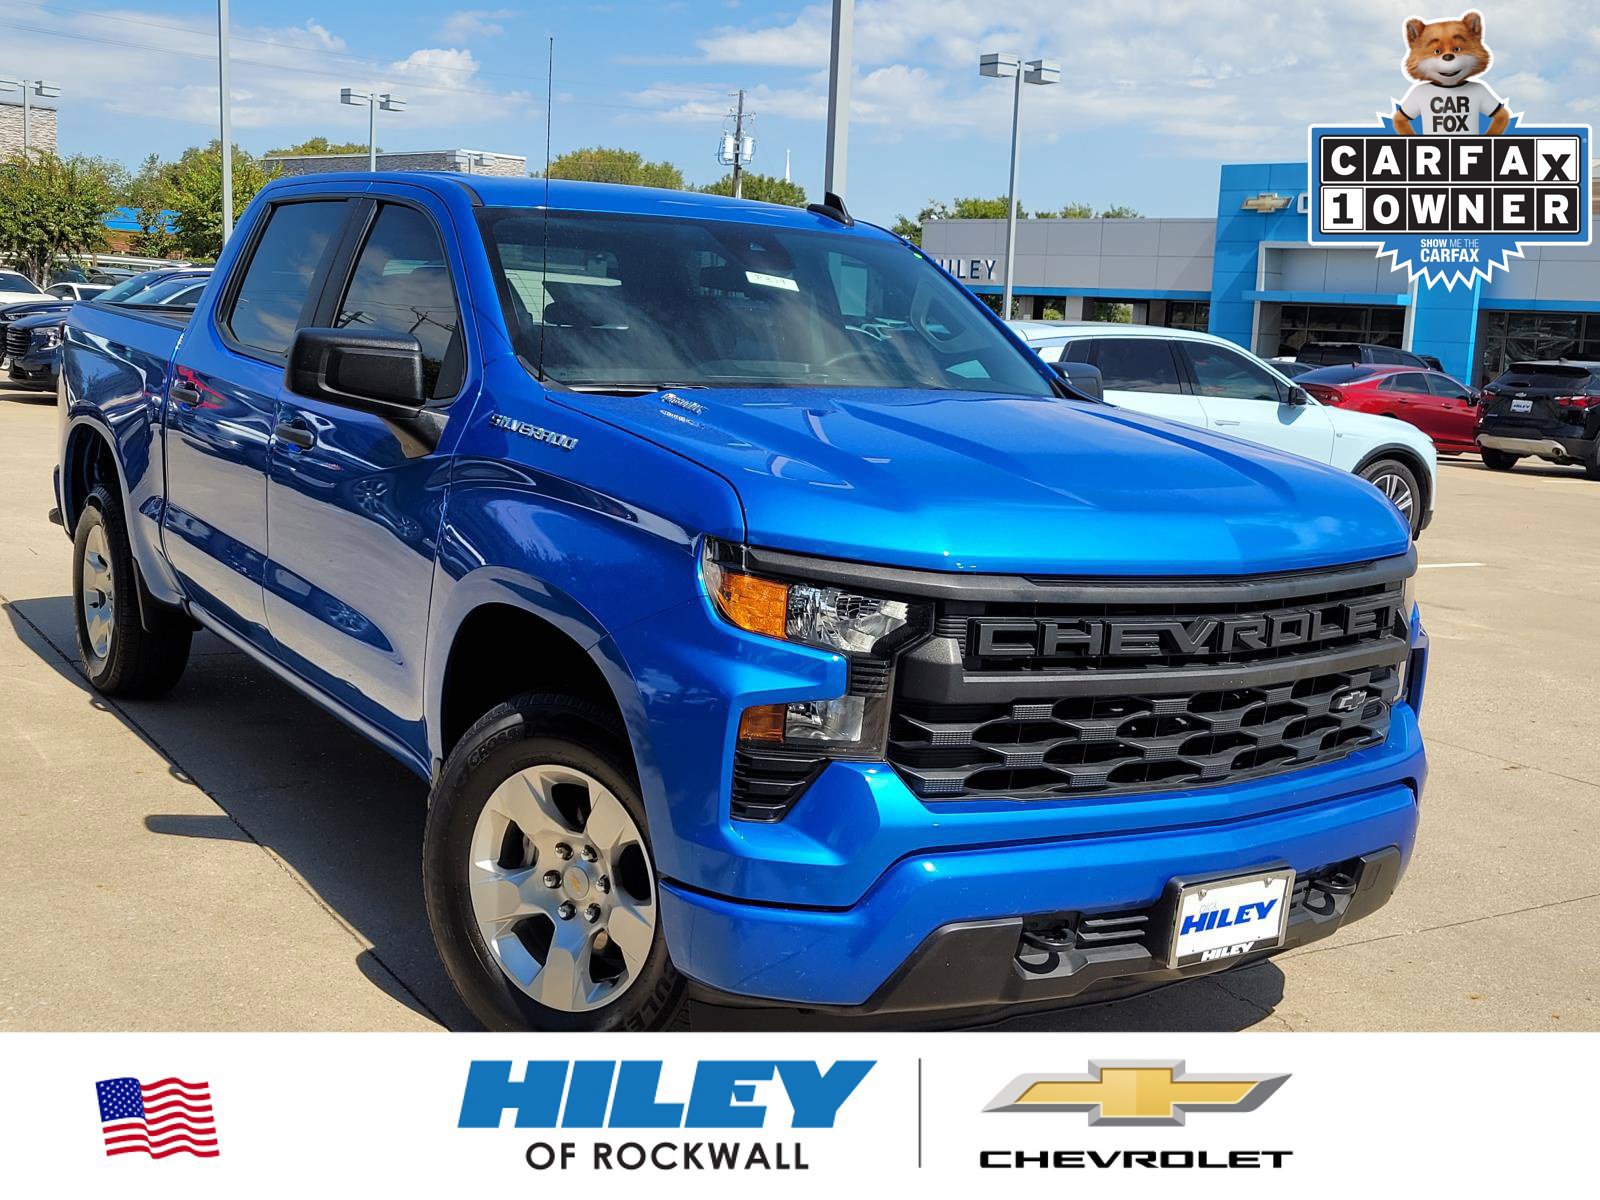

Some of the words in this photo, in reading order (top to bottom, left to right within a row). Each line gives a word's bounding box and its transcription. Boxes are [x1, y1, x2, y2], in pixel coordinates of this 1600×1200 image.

[489, 413, 579, 450] SILVERADO
[970, 602, 1395, 657] CHEVROLET
[1180, 898, 1278, 936] HILEY
[1200, 941, 1255, 962] HILEY
